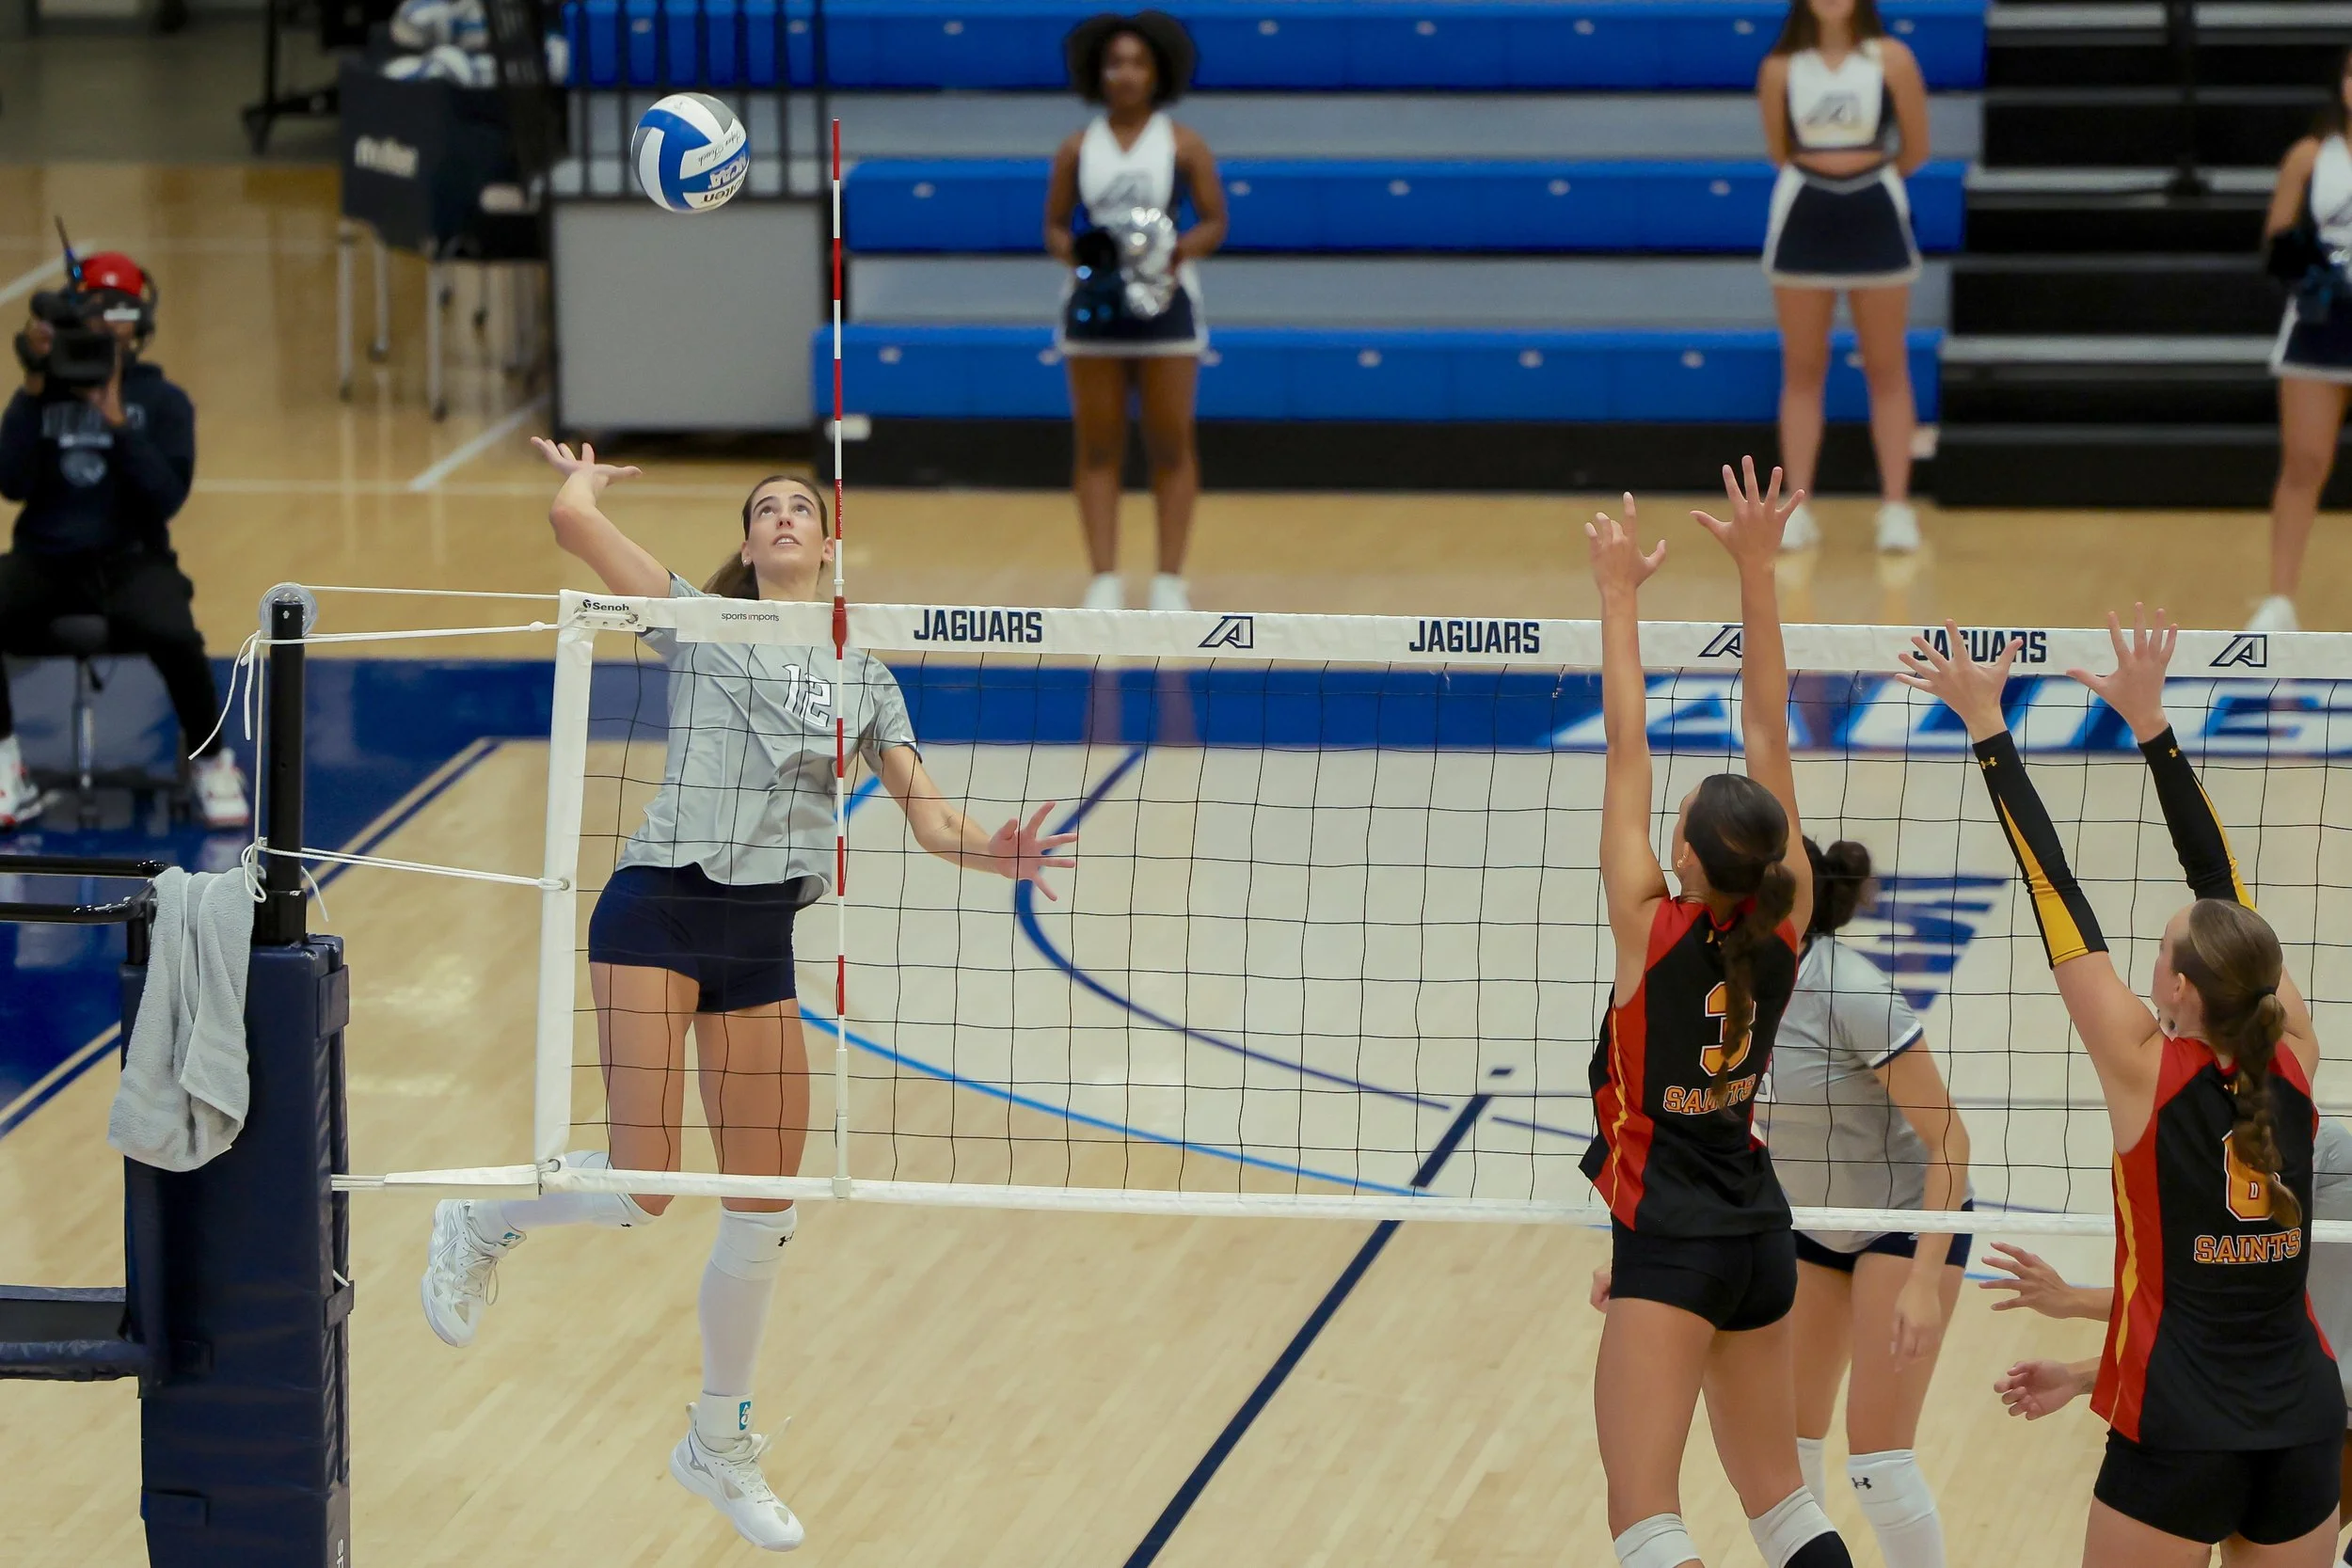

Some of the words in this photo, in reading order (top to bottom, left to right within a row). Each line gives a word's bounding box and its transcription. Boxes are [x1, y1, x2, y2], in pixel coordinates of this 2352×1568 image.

[592, 602, 629, 611] Senoh
[721, 612, 747, 622] sports
[914, 610, 1042, 643] JAGUARS
[1408, 620, 1539, 654] JAGUARS
[782, 663, 832, 728] 12
[1699, 981, 1757, 1076] 3
[2193, 1227, 2302, 1264] SAINTS
